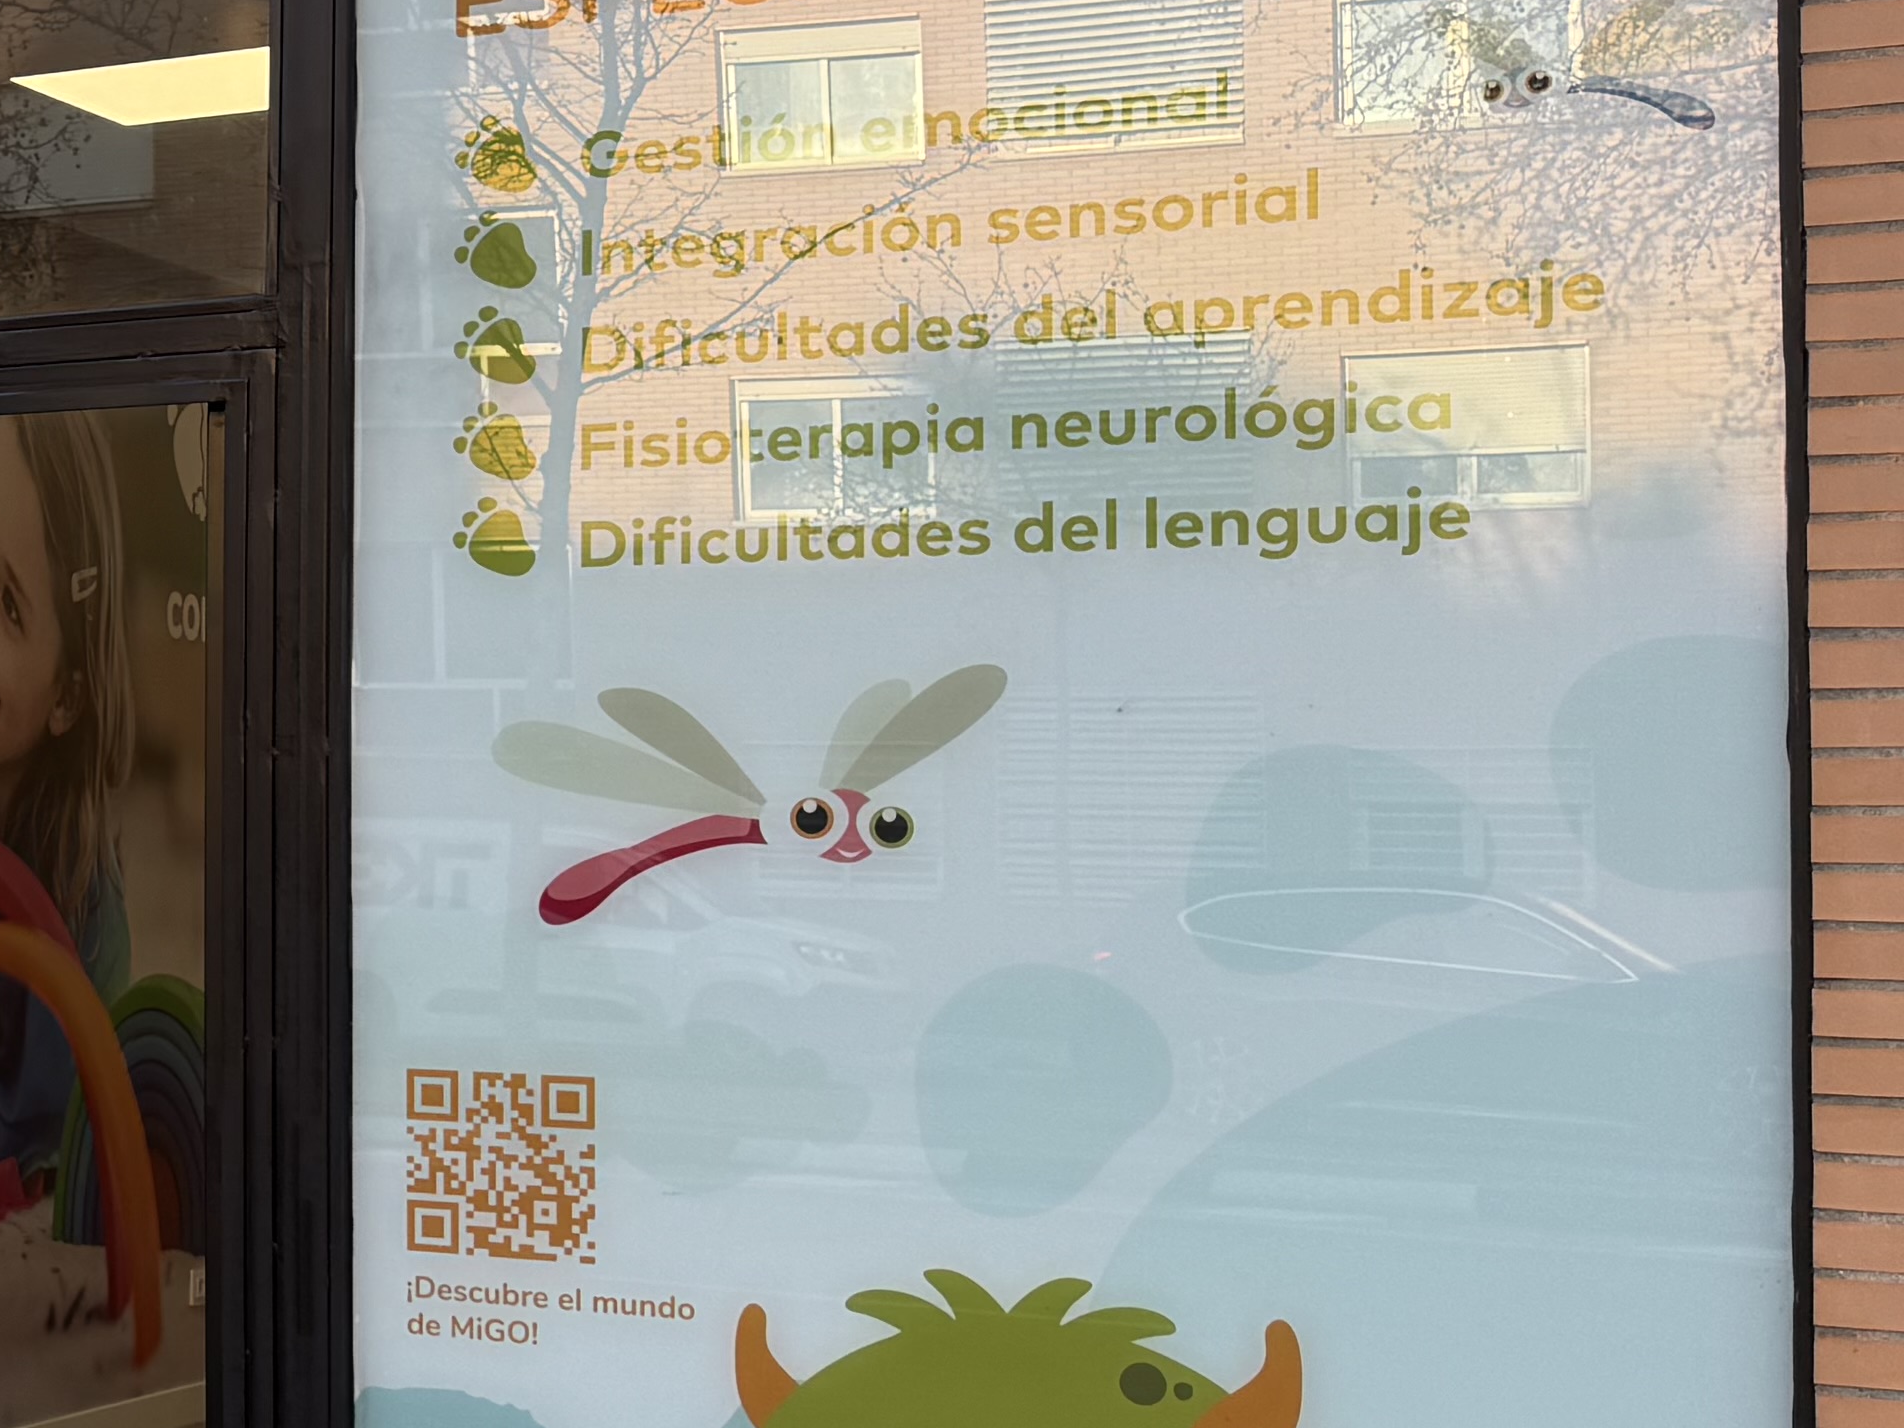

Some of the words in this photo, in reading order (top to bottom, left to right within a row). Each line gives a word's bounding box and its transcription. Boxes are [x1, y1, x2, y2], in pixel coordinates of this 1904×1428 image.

[580, 113, 831, 179] Gestión
[859, 70, 1230, 155] emocional
[580, 199, 963, 279] Integración
[987, 168, 1320, 245] sensorial
[580, 304, 991, 375] Dificultades
[1014, 289, 1117, 346] del
[1144, 258, 1606, 350] aprendizaje
[579, 402, 985, 470] Fisioterapia
[1011, 381, 1454, 452] neurológica
[579, 504, 992, 569] Dificultades
[1013, 497, 1117, 554] del
[1146, 486, 1472, 560] lenguaje
[406, 1275, 549, 1309] ¡Descubre
[558, 1288, 582, 1312] el
[592, 1295, 696, 1321] mundo
[407, 1313, 441, 1337] de
[450, 1316, 539, 1346] MiGO!
